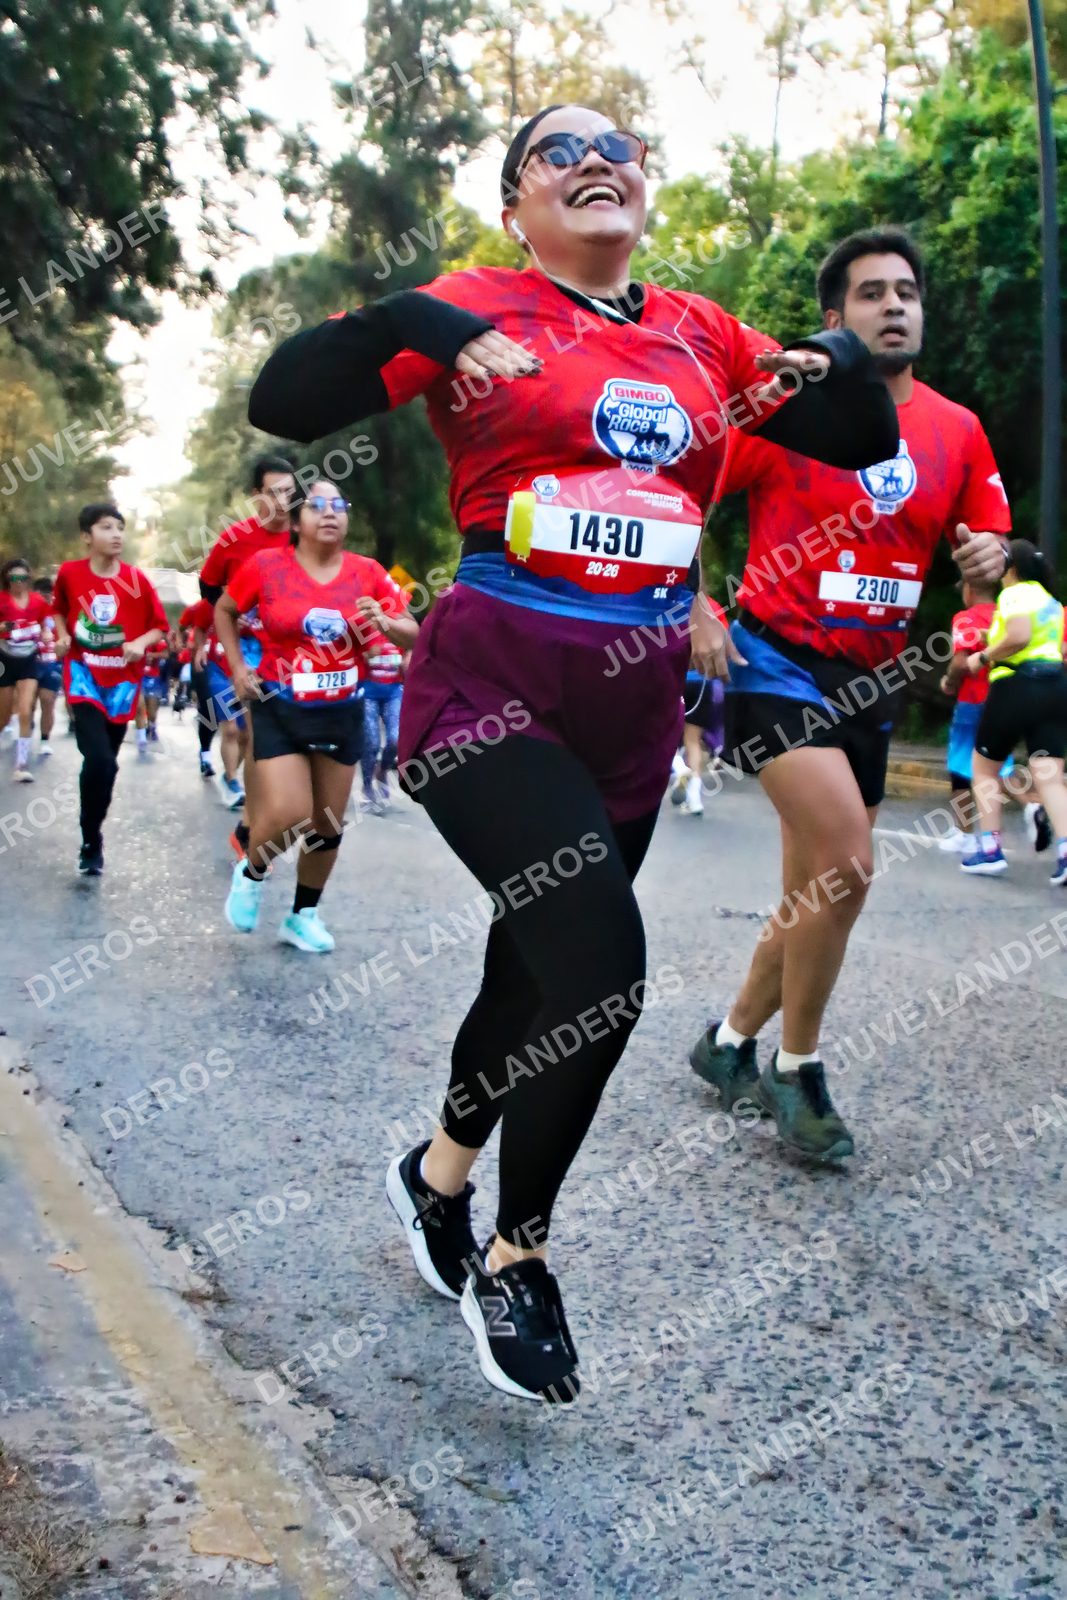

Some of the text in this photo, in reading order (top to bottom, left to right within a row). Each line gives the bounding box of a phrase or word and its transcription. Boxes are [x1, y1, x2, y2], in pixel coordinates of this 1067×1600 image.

[614, 387, 666, 403] BIMBO
[618, 403, 667, 424] Global
[607, 415, 651, 434] Race
[569, 512, 644, 559] 1430
[585, 561, 620, 578] 20-26
[653, 587, 668, 599] 5K
[855, 576, 900, 604] 2300
[317, 671, 347, 689] 2728
